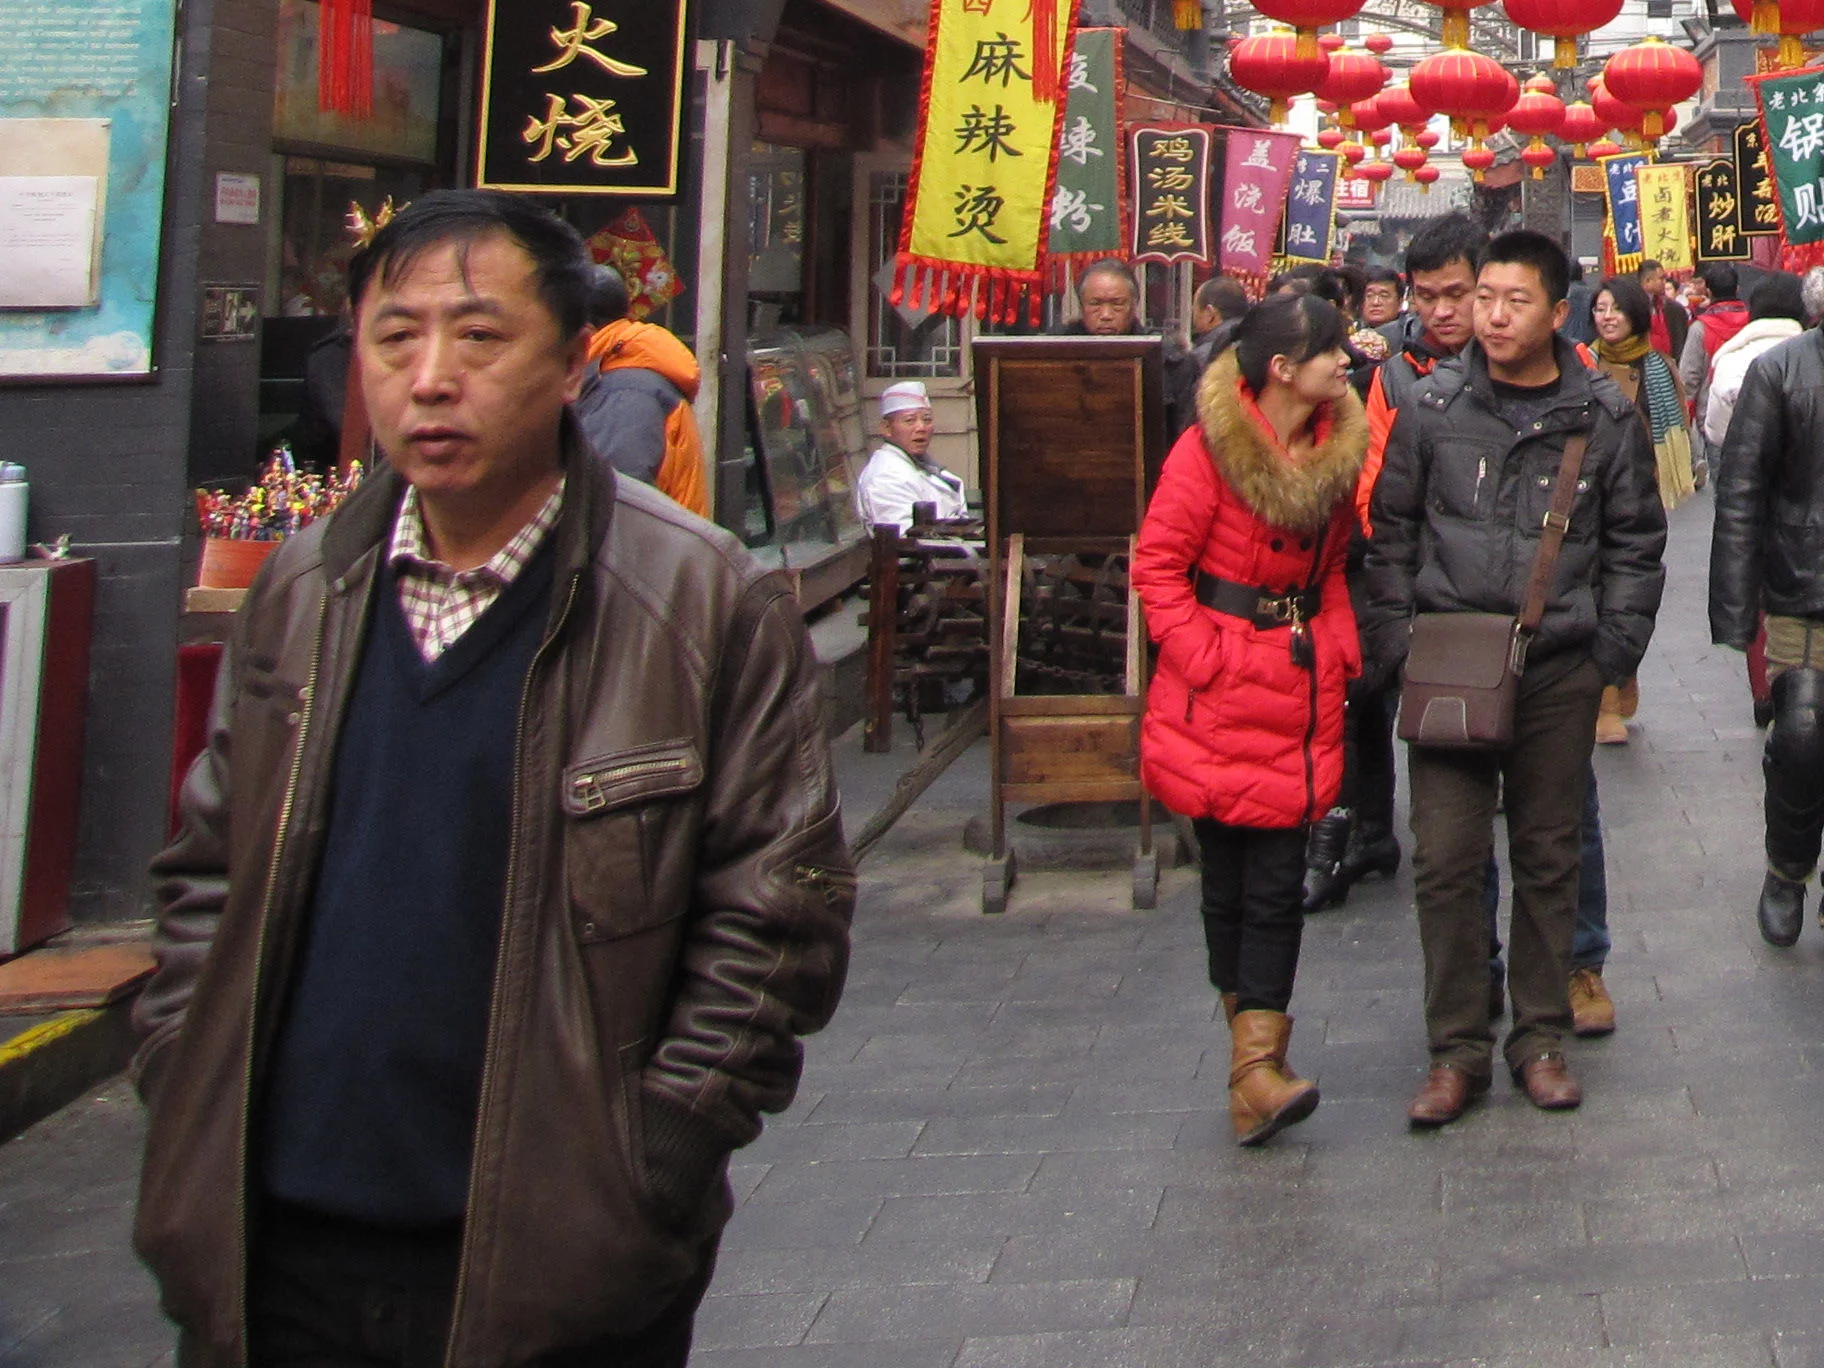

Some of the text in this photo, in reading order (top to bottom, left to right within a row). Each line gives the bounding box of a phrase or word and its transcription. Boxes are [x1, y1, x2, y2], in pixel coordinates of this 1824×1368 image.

[947, 31, 1033, 245] 麻辣烫
[1145, 136, 1195, 248] 鸡汤米线
[1221, 138, 1278, 258] 盖浇饭
[1286, 178, 1326, 246] 爆肚
[1708, 191, 1737, 254] 炒肝
